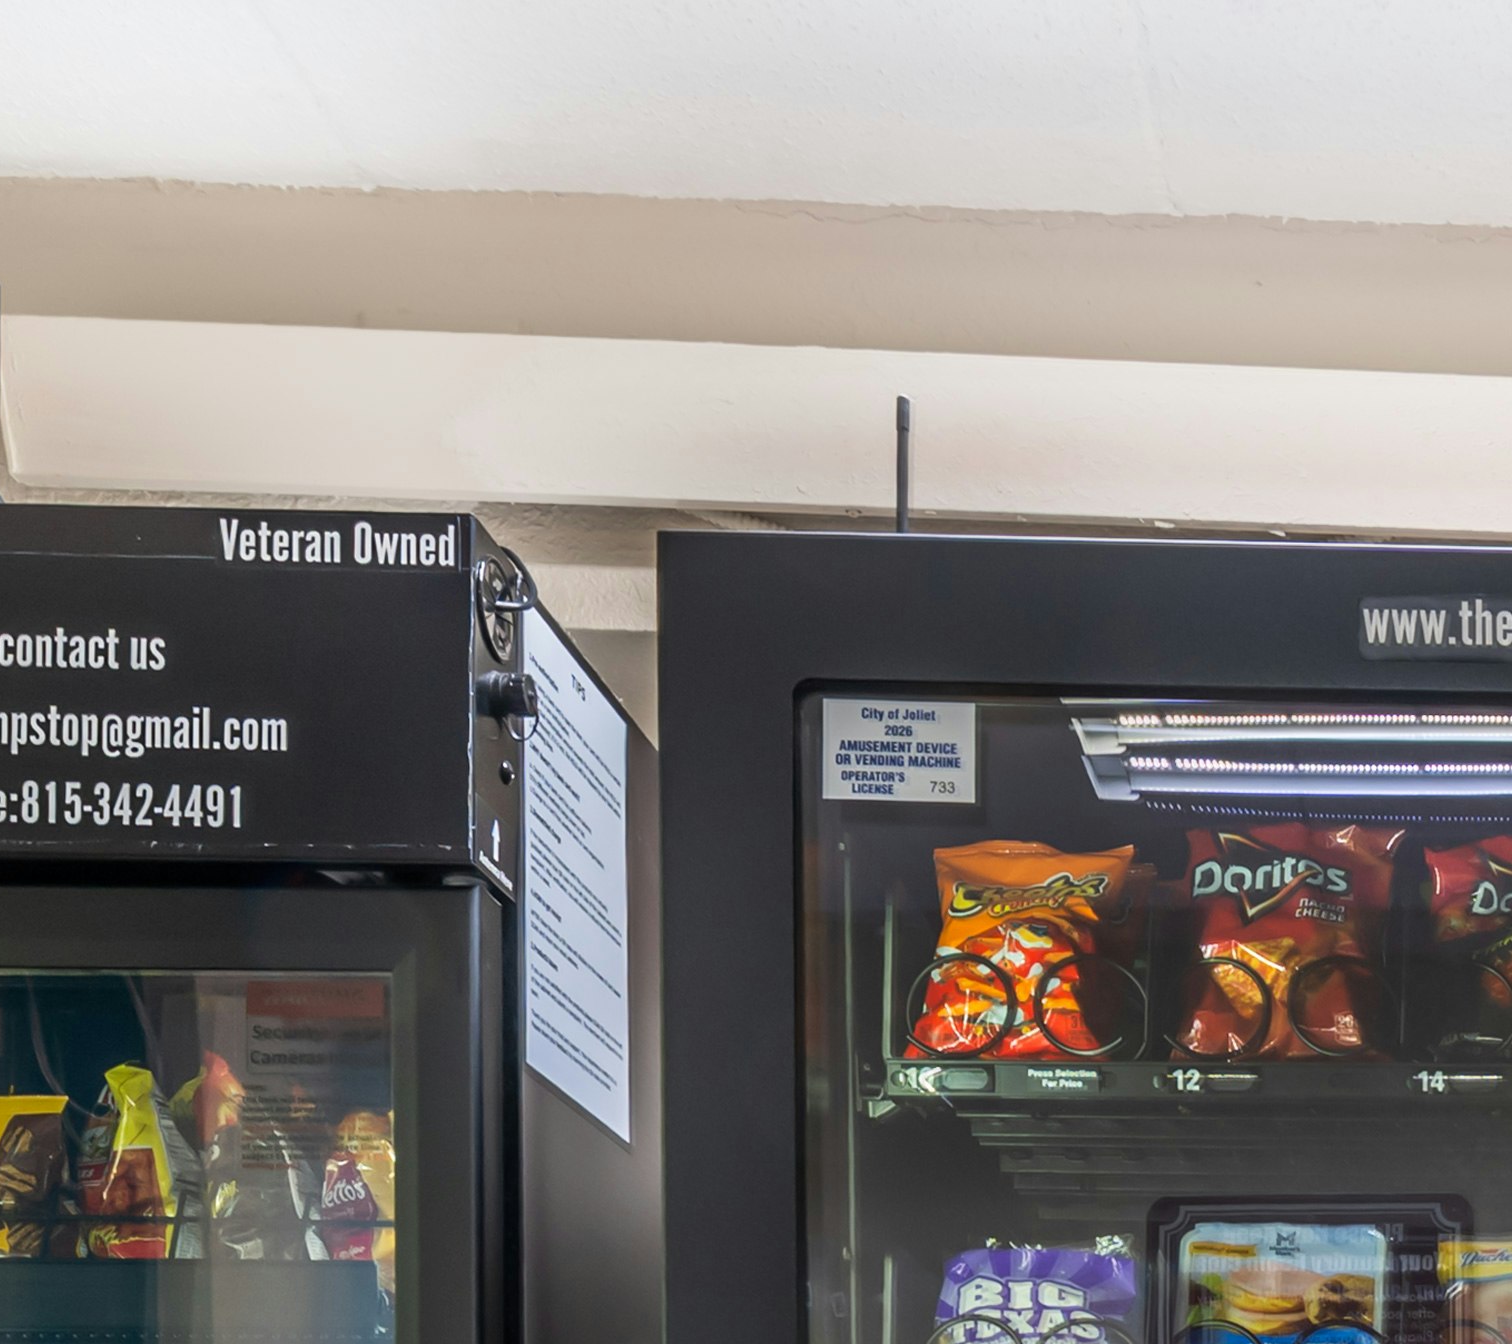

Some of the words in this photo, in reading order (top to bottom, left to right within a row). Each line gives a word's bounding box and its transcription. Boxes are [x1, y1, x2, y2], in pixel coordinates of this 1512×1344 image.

[218, 518, 340, 566] Veteran
[352, 523, 456, 567] Owned
[130, 633, 166, 671] us
[861, 708, 884, 721] City
[888, 709, 899, 719] of
[903, 710, 935, 721] Joliet
[884, 725, 913, 736] 2026
[839, 740, 912, 753] AMUSEMENT
[916, 742, 957, 754] DEVICE
[835, 754, 851, 765] OR
[855, 755, 904, 766] VENDING
[908, 756, 961, 768] MACHINE
[841, 771, 905, 782] OPERATOR'S
[852, 783, 893, 794] LICENSE
[930, 781, 955, 793] 733
[1193, 857, 1348, 897] Doritos
[1295, 908, 1345, 922] CHEESE
[1028, 1069, 1052, 1078] Press
[1055, 1069, 1097, 1078] Selection
[1173, 1068, 1199, 1090] 12
[1041, 1079, 1057, 1087] For
[1060, 1079, 1083, 1087] Price
[1418, 1072, 1445, 1092] 14
[959, 1278, 1085, 1314] BIG
[947, 1309, 1100, 1343] TEXAS
